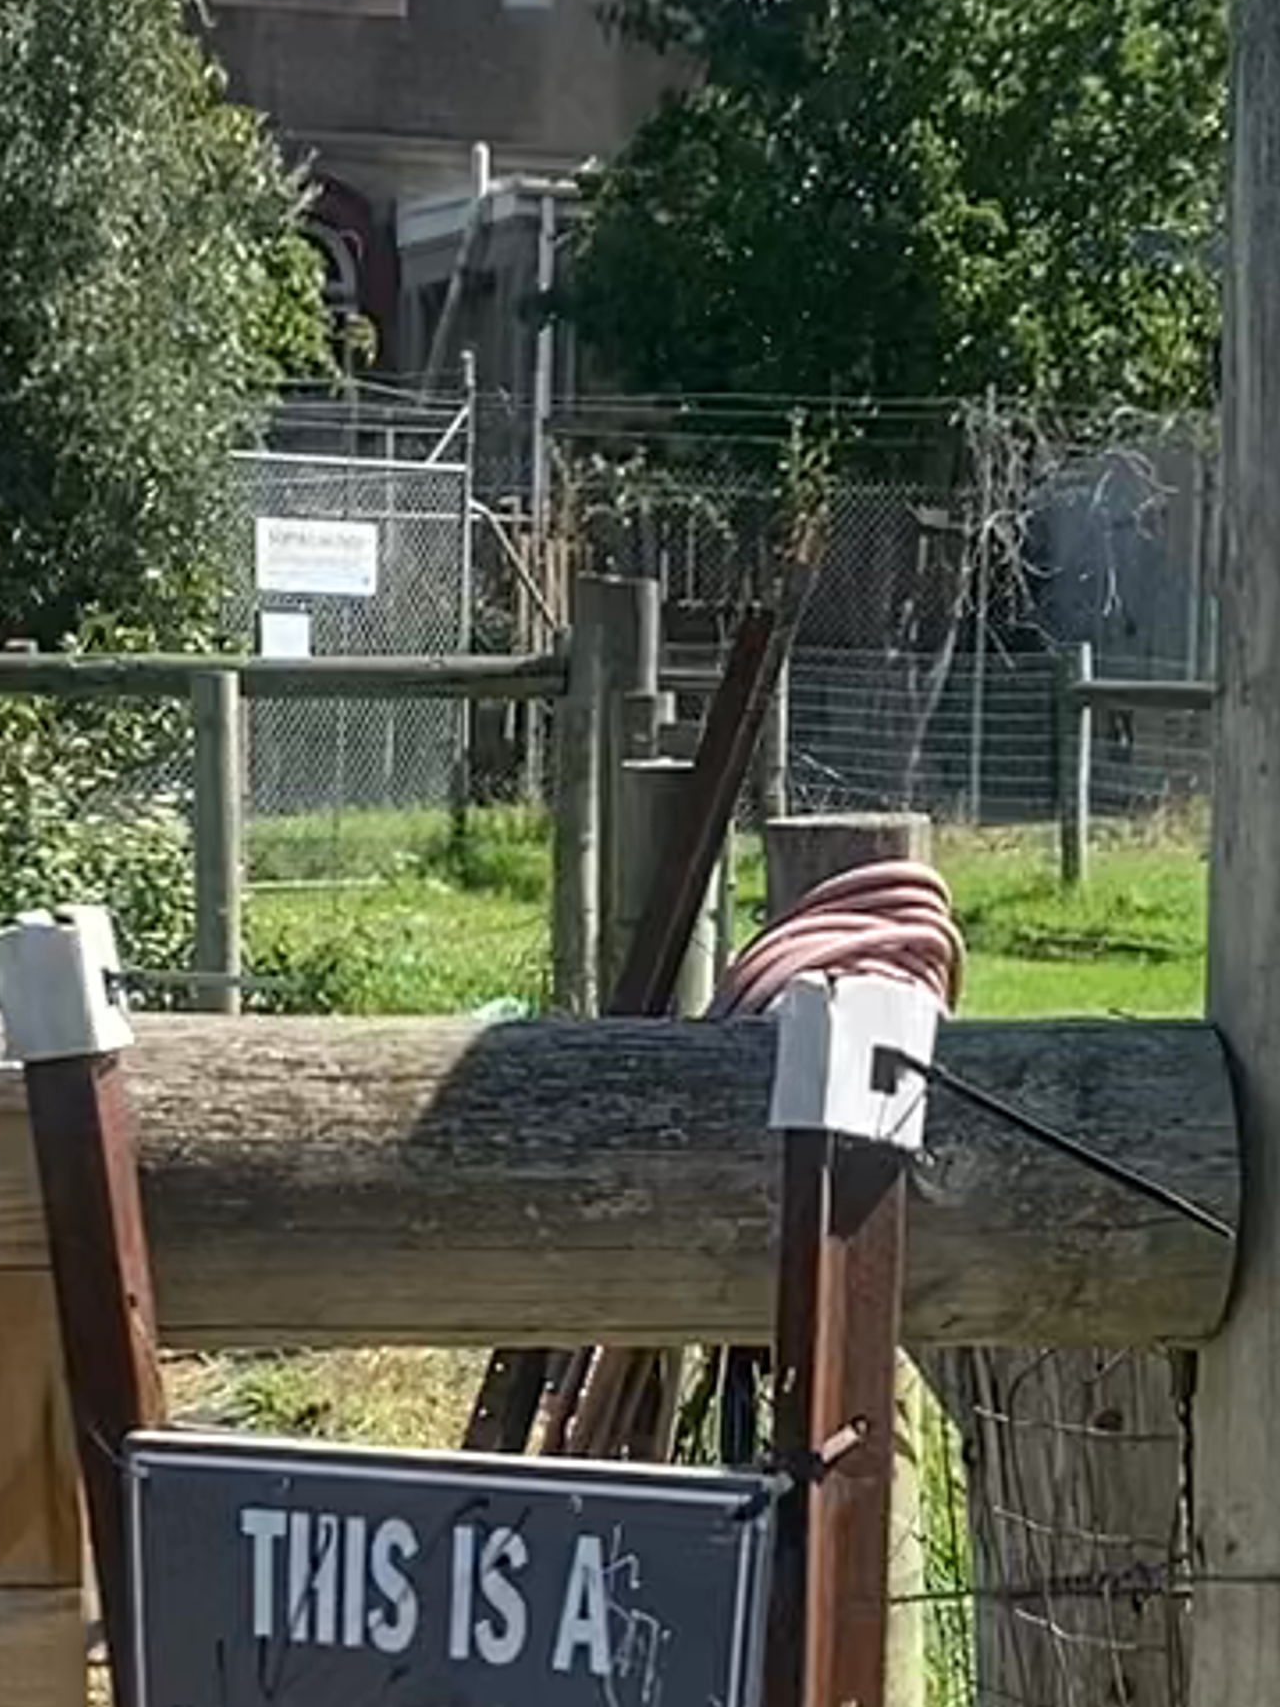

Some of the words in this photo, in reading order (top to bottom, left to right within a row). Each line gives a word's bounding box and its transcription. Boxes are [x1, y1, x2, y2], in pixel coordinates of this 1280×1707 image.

[240, 1507, 420, 1654] THIS
[449, 1522, 529, 1665] IS
[552, 1535, 613, 1677] A
